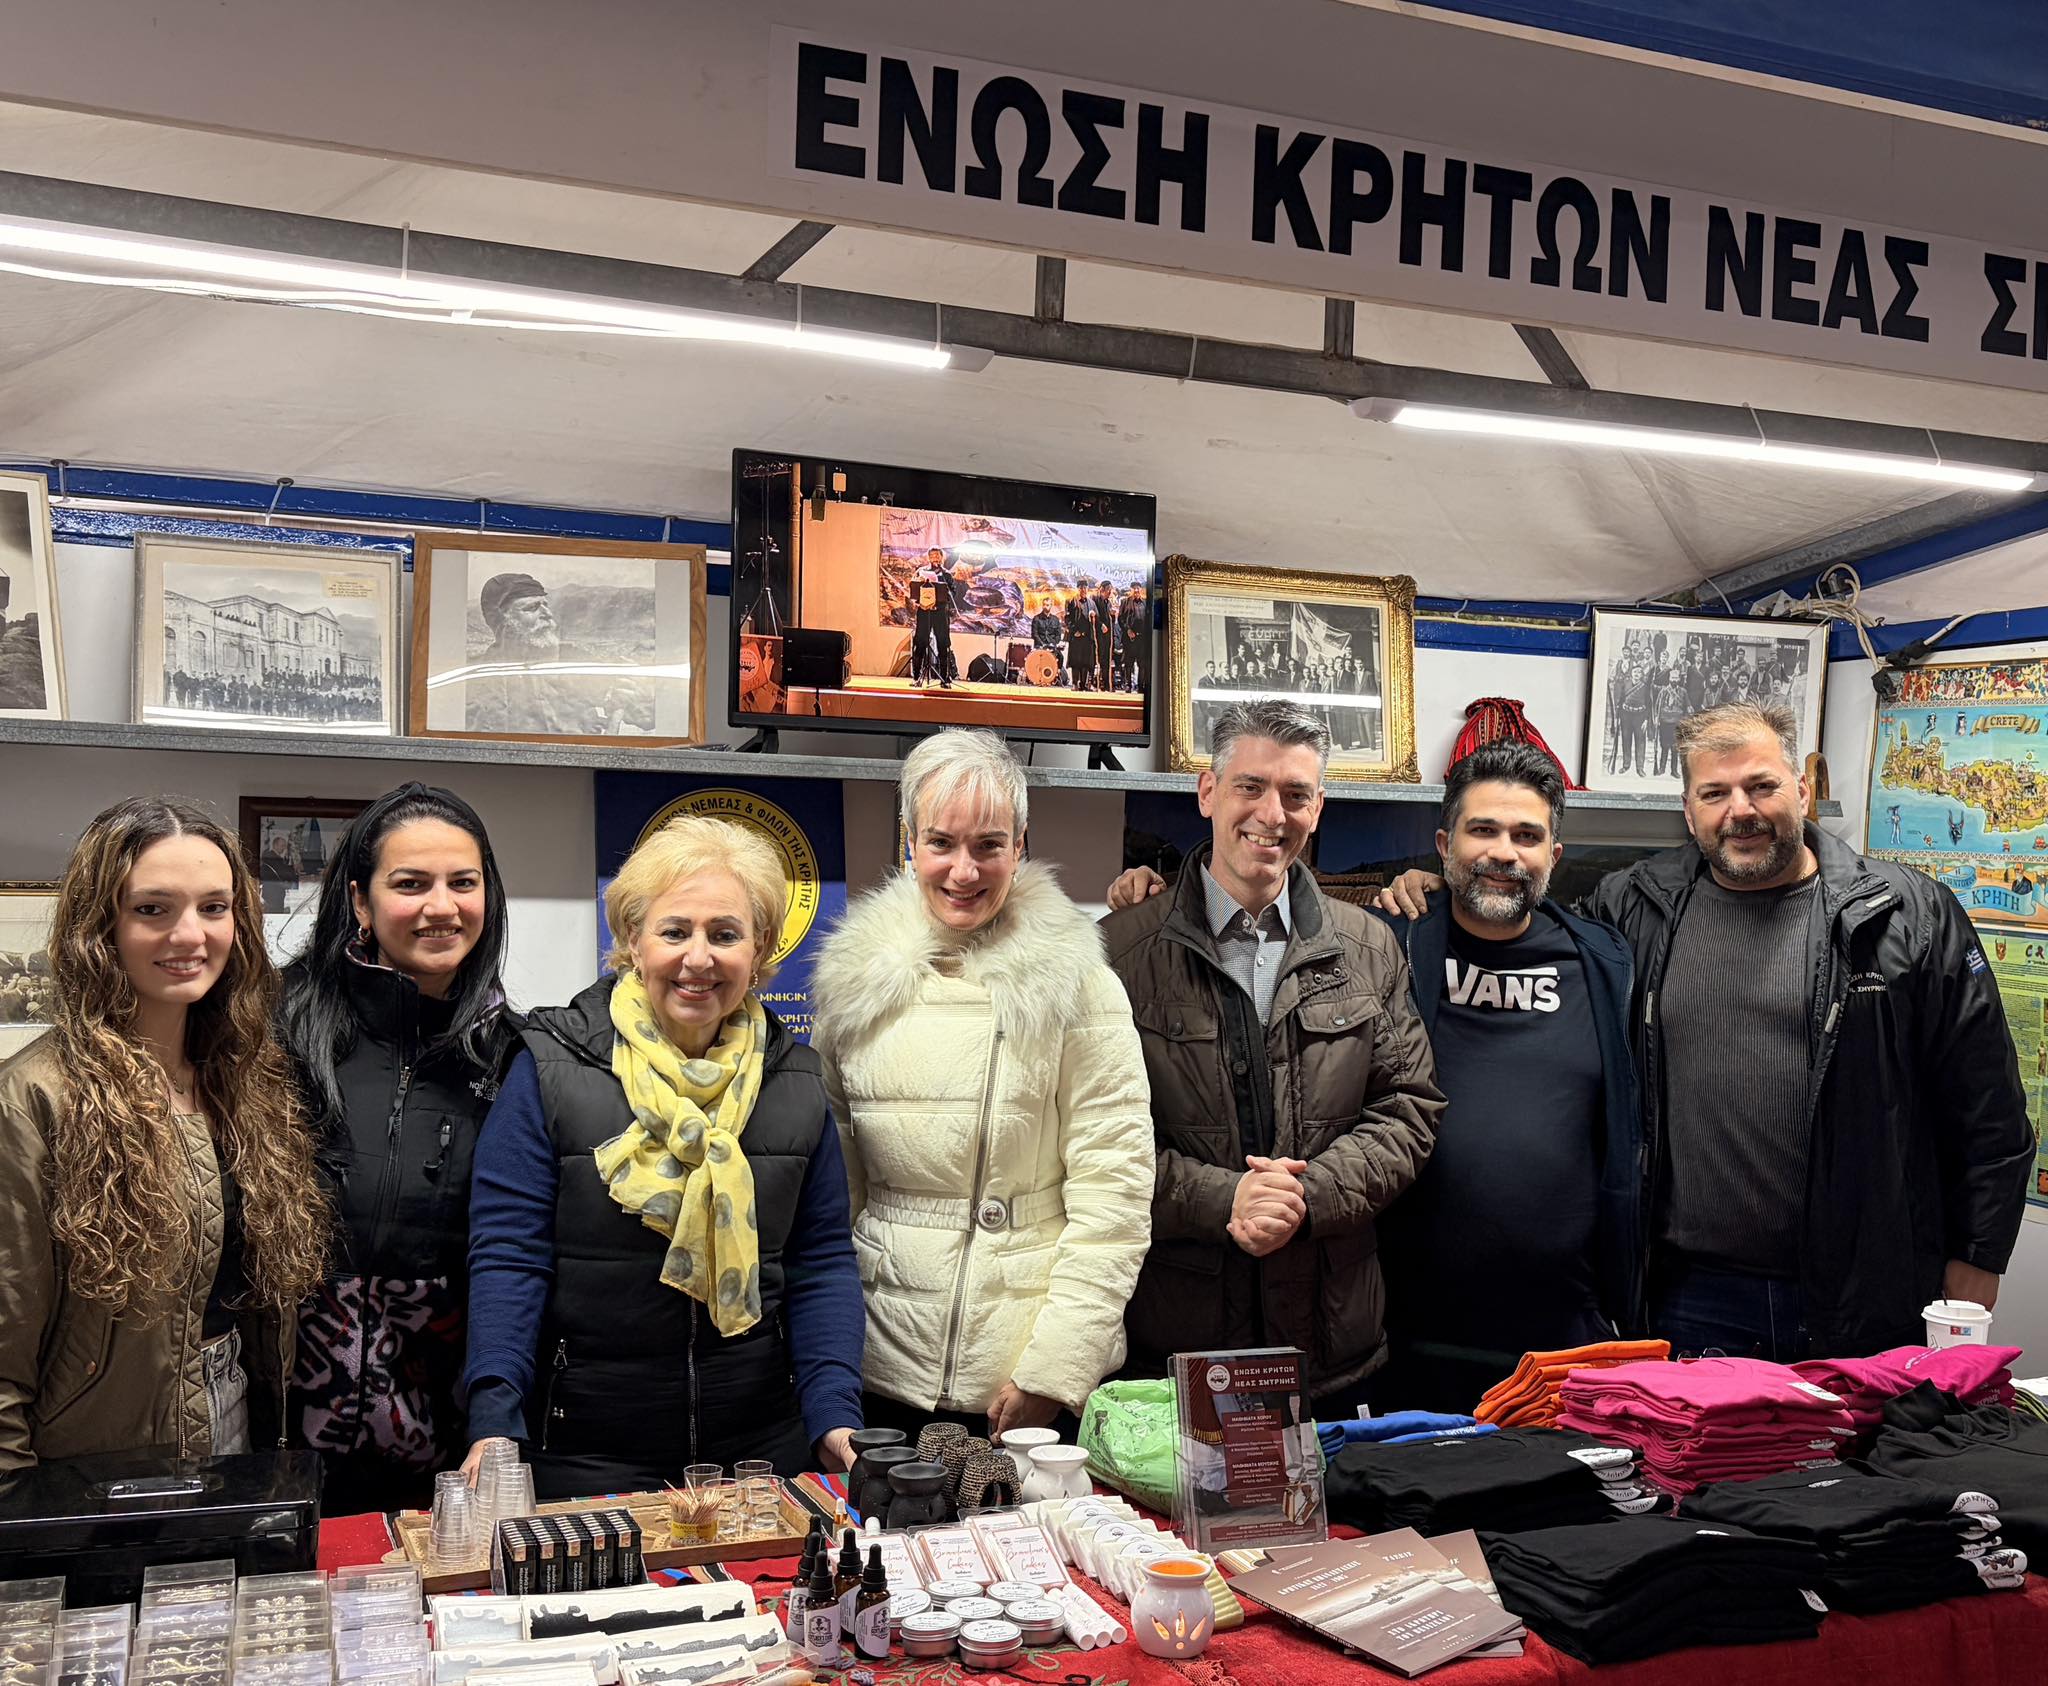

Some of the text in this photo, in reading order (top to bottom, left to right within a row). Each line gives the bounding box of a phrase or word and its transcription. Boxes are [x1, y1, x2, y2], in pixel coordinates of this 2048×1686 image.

[795, 42, 1210, 233] ΕΝΩΣΗ
[1251, 123, 1671, 304] ΚΡΗΤΩΝ
[1705, 204, 1930, 343] ΝΕΑΣ
[1990, 716, 2019, 726] CRETE
[690, 798, 742, 813] ΝΕΜΕΑΣ
[745, 803, 754, 814] &
[757, 808, 792, 838] ΦΙΛΩΝ
[787, 835, 806, 861] ΤΗΣ
[798, 862, 813, 911] ΚΡΗΤΗΣ
[1971, 889, 2020, 911] ΚΡΗΤΗ
[1445, 958, 1561, 1013] VANS
[1234, 1366, 1295, 1376] ΕΝΩΣΗ ΚΡΗΤΩΝ
[1235, 1377, 1296, 1388] ΝΕΑΣ ΣΜΥΡΝΗΣ
